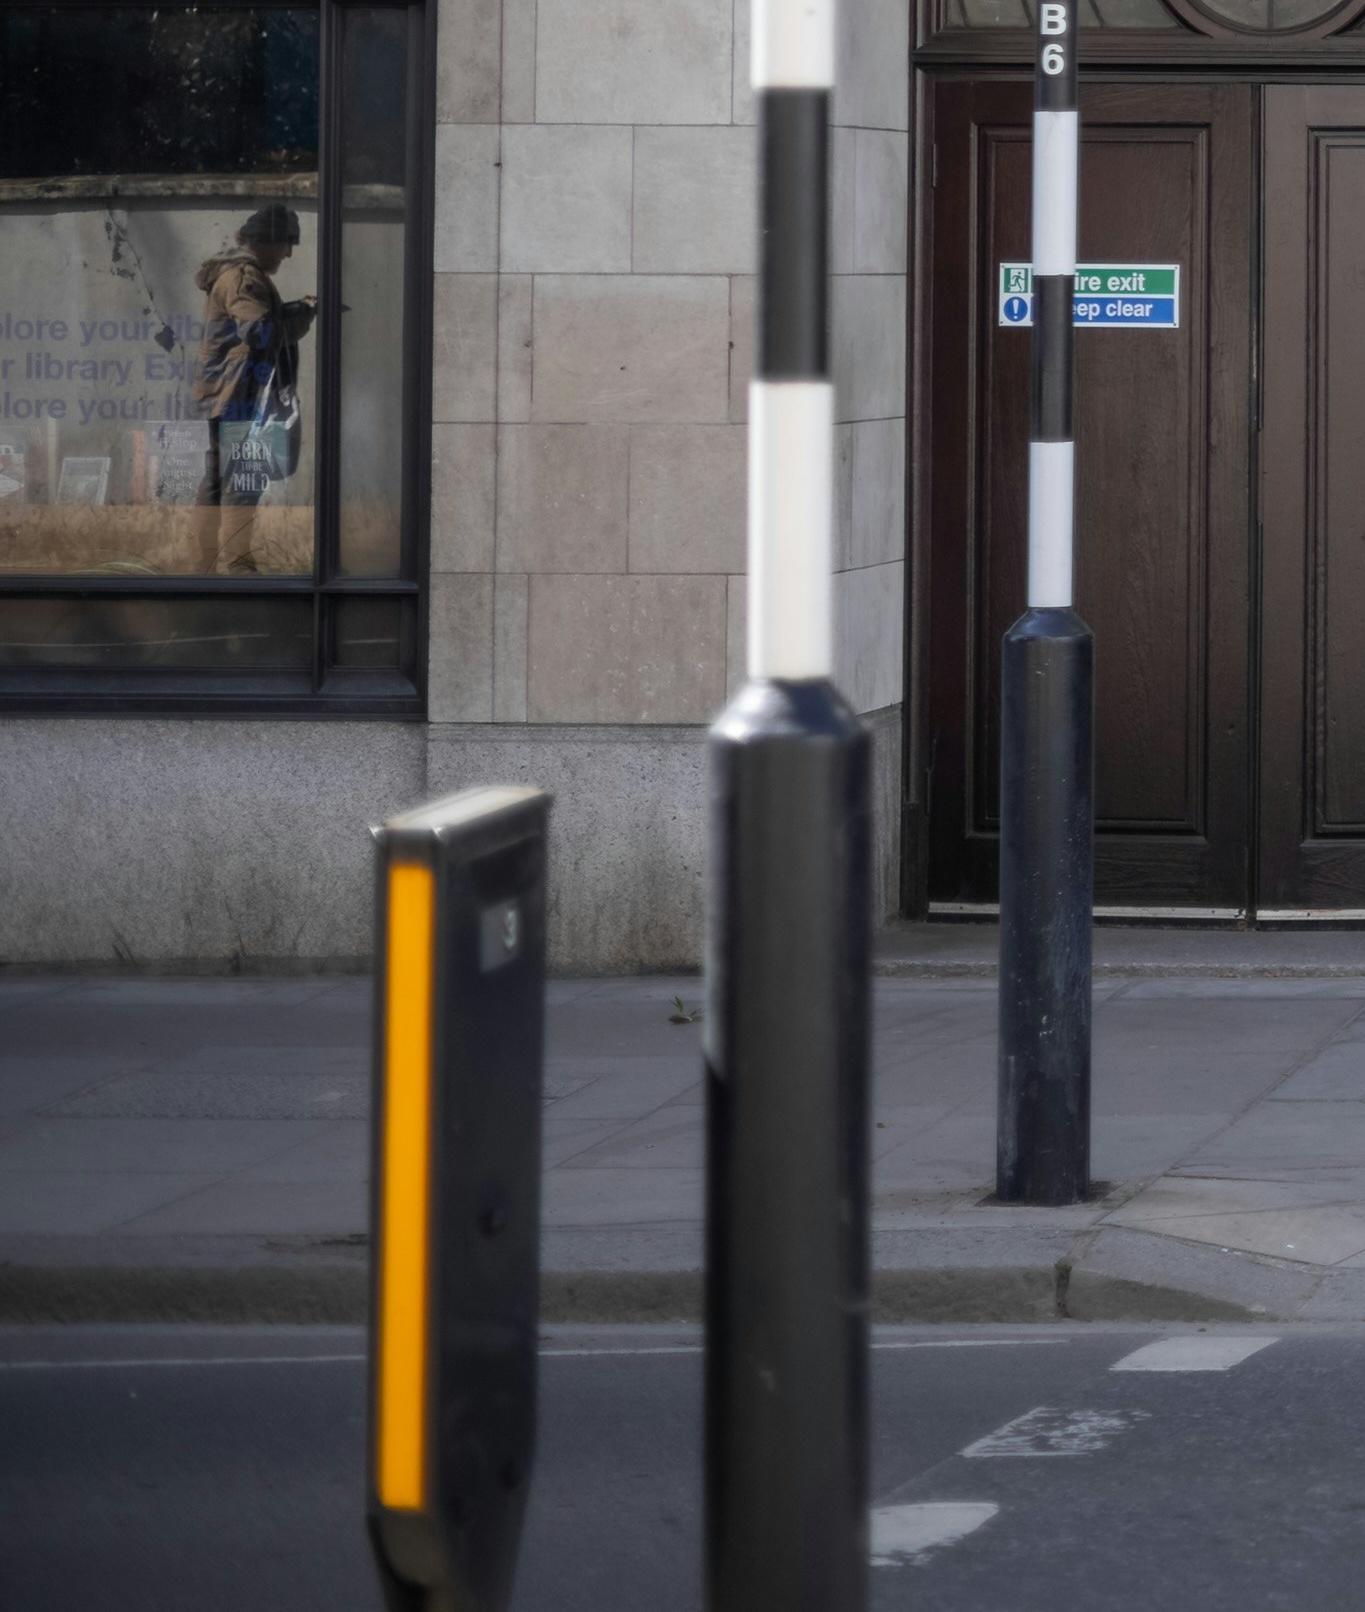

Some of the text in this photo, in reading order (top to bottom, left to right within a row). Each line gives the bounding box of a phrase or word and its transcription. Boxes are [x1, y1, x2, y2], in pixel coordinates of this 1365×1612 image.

[1074, 272, 1146, 292] ire exit
[1072, 300, 1154, 320] ep clear
[0, 313, 69, 342] lore
[79, 318, 154, 346] your
[25, 352, 133, 387] library
[0, 392, 67, 420] lore
[77, 397, 154, 425] your
[231, 441, 273, 461] BORN
[166, 457, 189, 467] One
[253, 462, 263, 471] BE
[164, 480, 193, 492] Night
[233, 473, 271, 492] MILD
